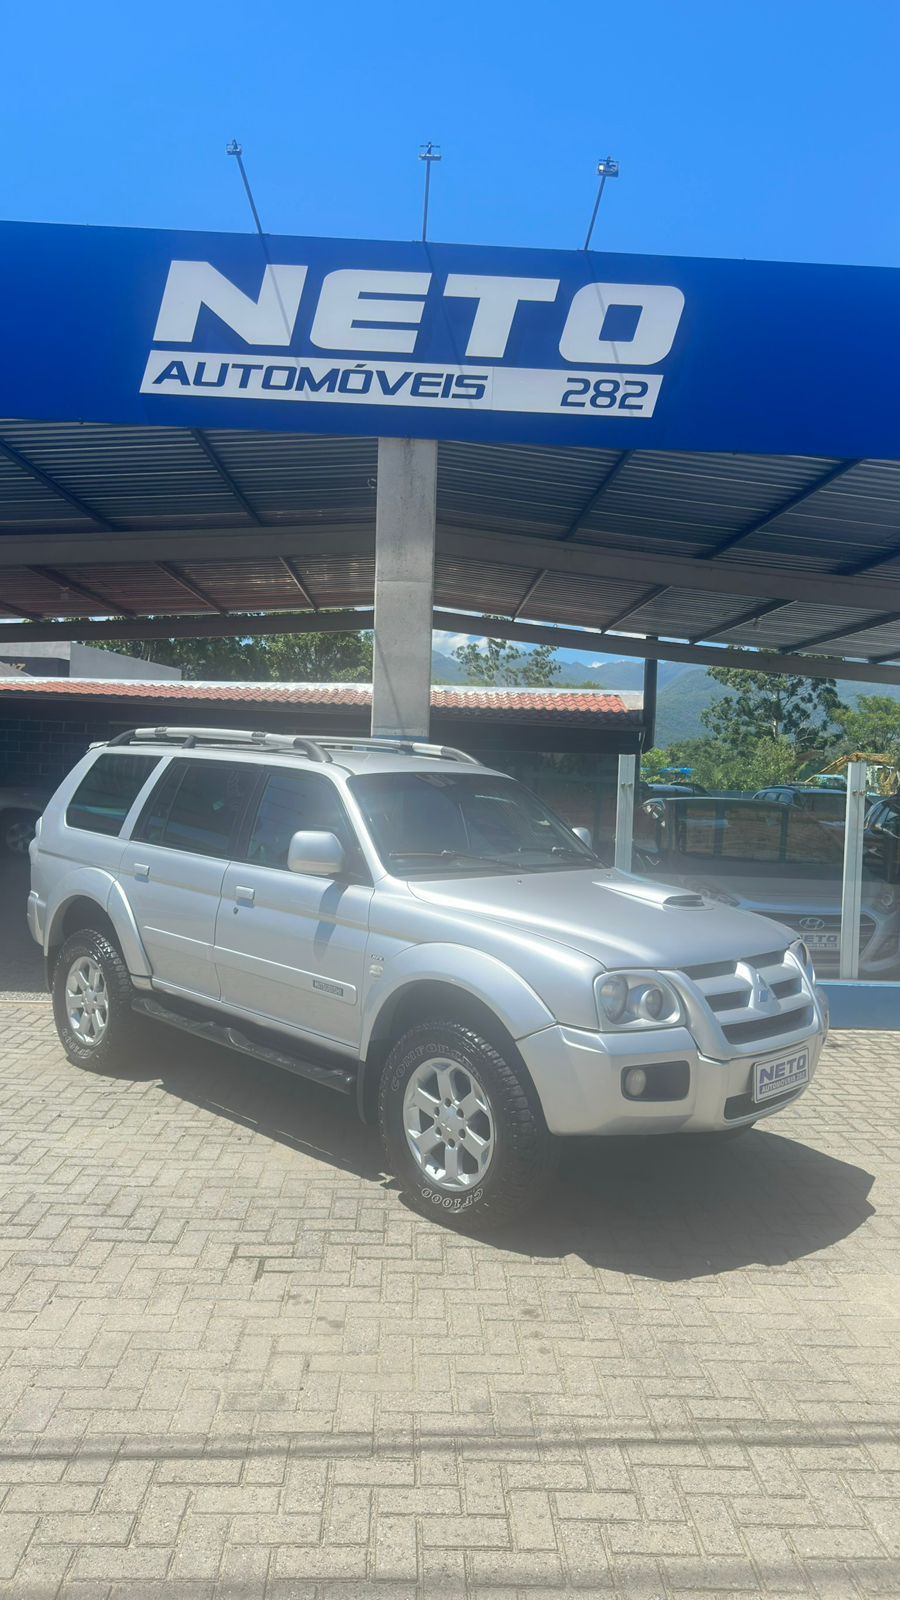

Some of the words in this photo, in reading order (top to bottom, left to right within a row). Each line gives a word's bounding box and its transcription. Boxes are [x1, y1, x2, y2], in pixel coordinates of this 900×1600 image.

[152, 260, 685, 366] NETO
[152, 361, 489, 400] AUTOMÓVEIS
[560, 377, 649, 411] 282
[760, 1054, 807, 1084] NETO
[421, 1187, 484, 1209] CF1000
